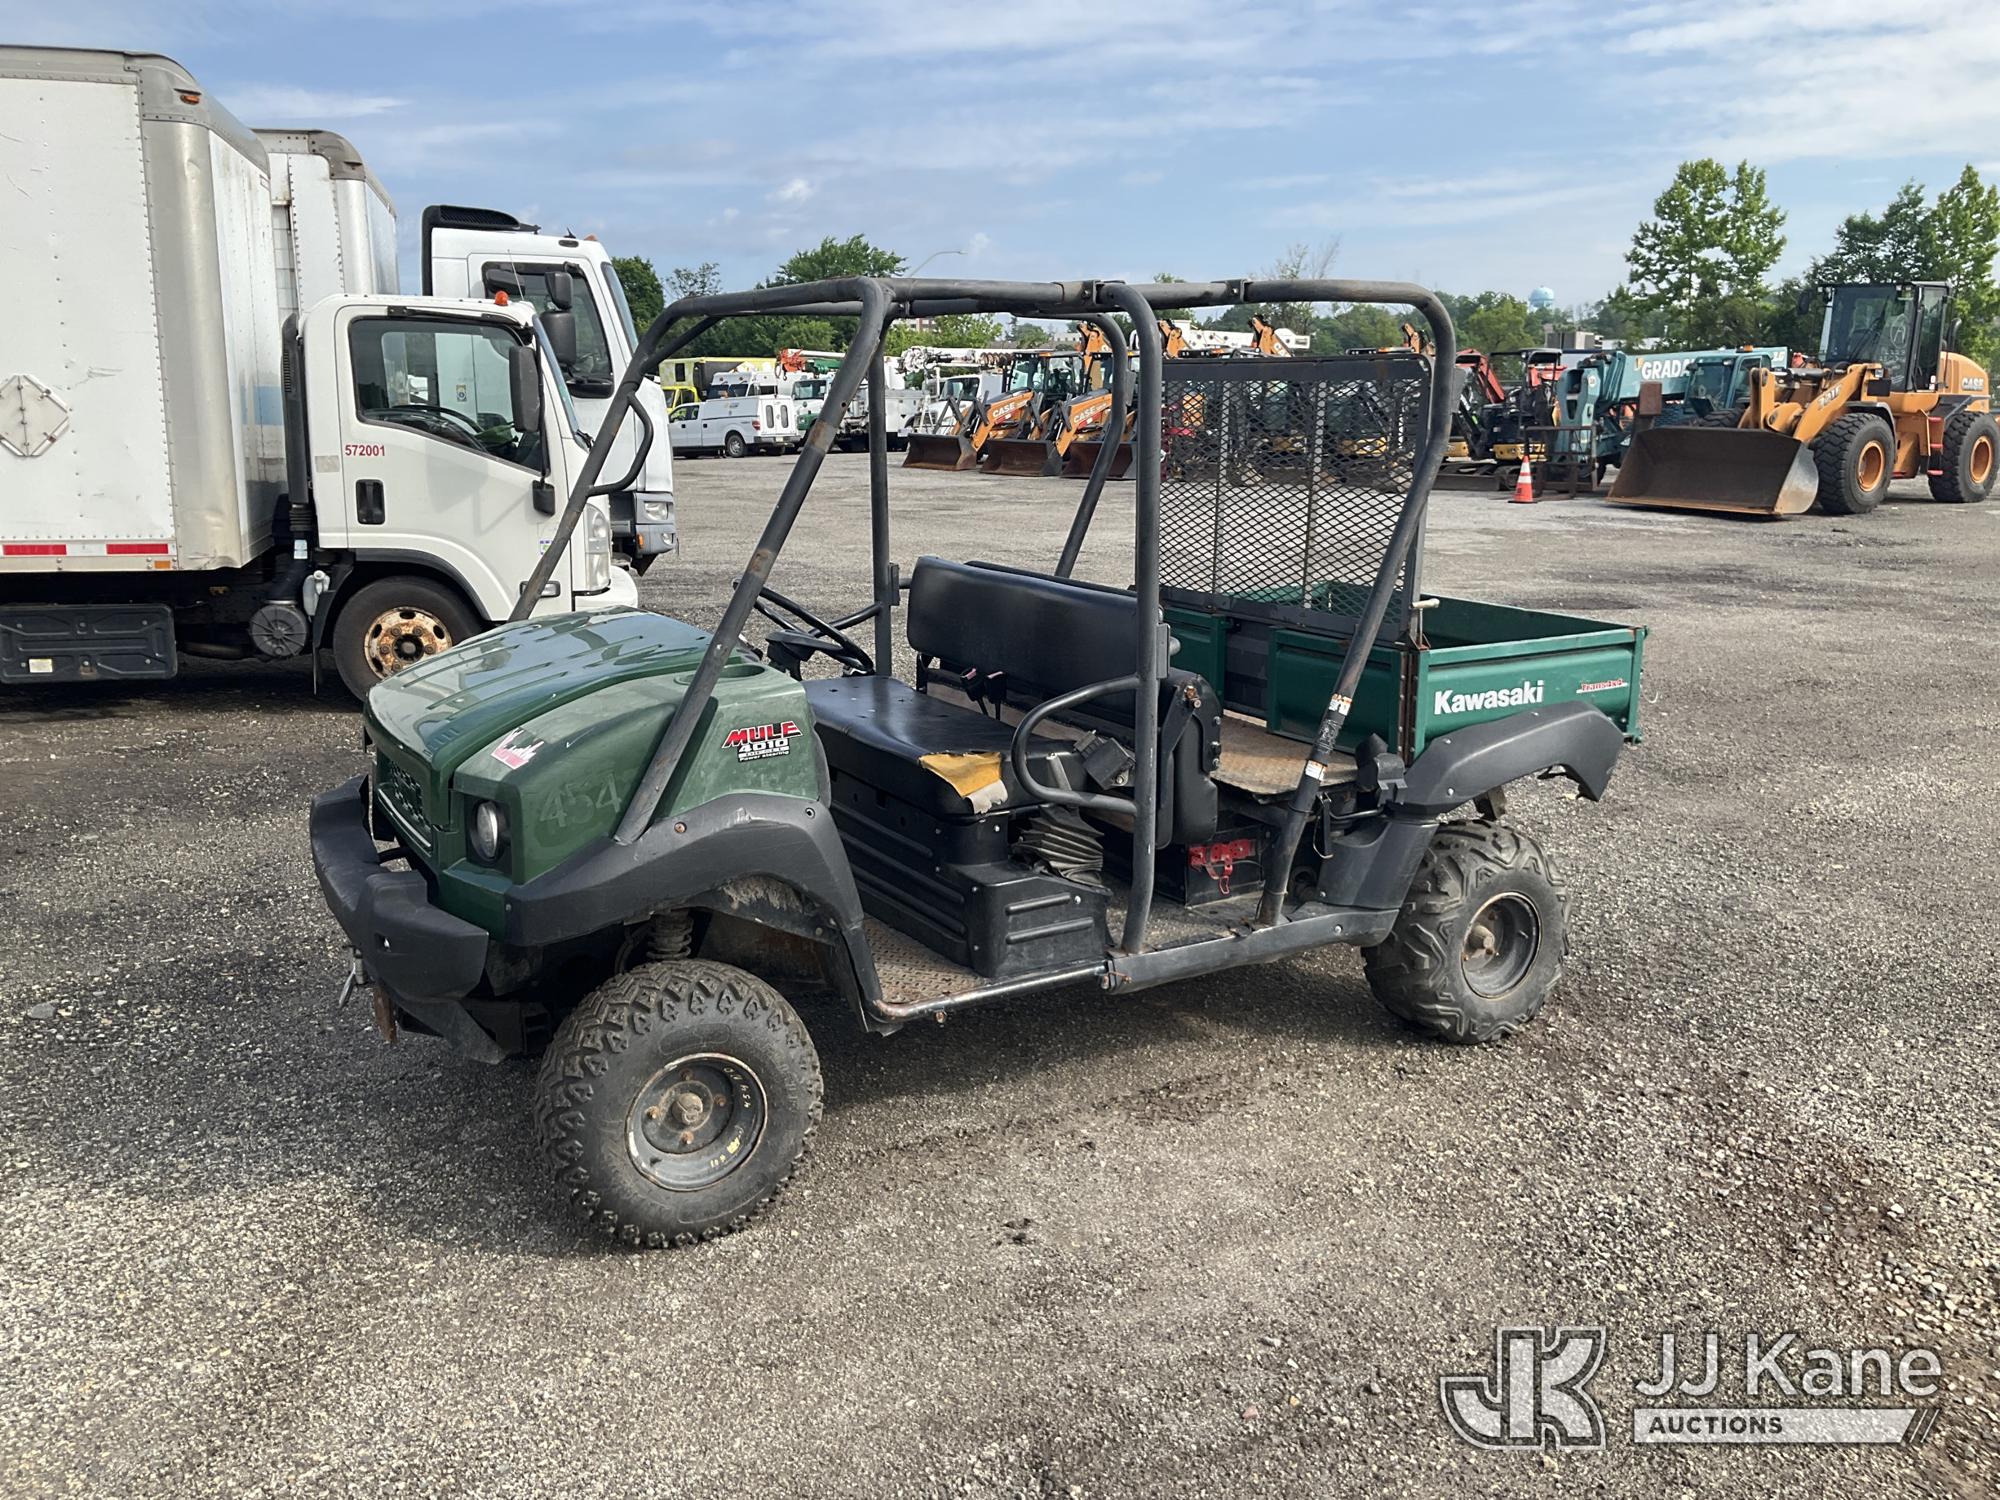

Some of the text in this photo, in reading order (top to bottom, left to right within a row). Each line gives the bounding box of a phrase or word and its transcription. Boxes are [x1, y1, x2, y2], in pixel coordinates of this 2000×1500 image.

[1642, 358, 1699, 380] GRADA
[992, 403, 1016, 419] CASE
[1073, 406, 1098, 424] CASE
[345, 444, 385, 456] 572001
[1434, 680, 1545, 715] Kawasaki
[721, 720, 803, 749] MULE
[739, 738, 789, 752] 4010
